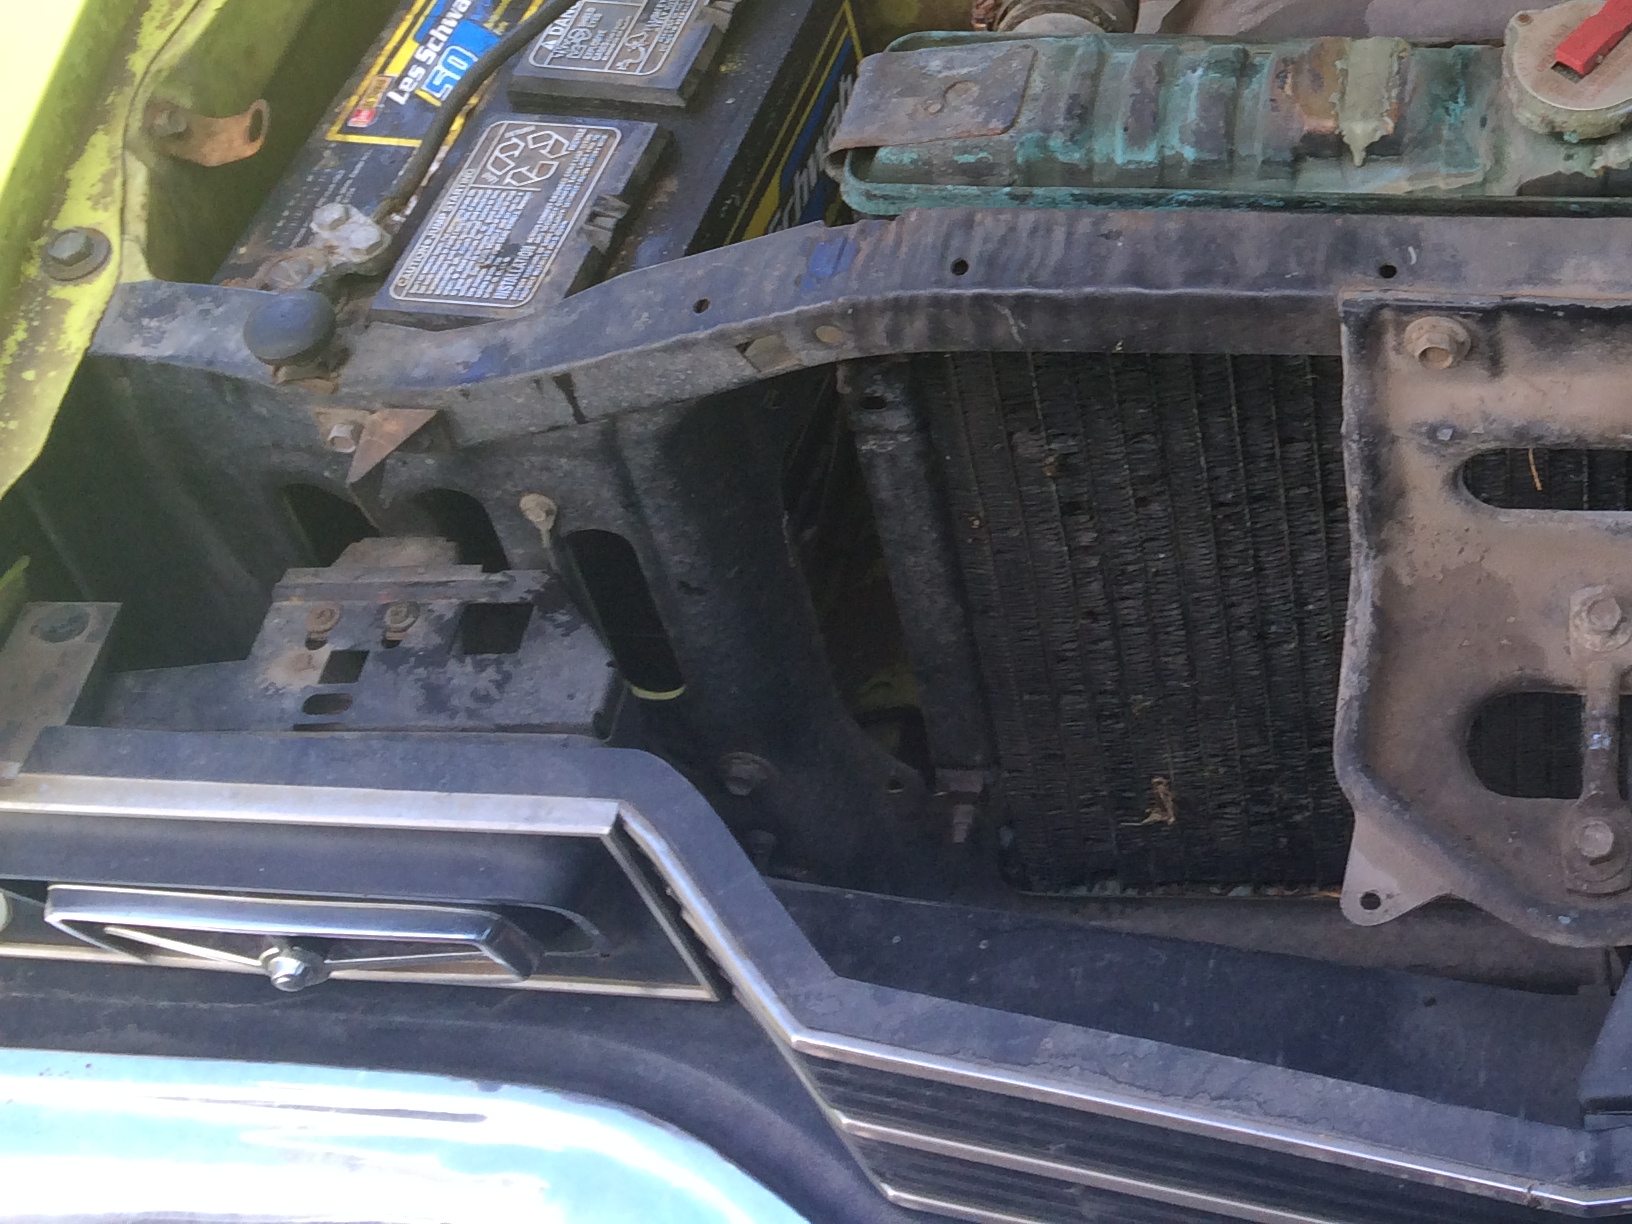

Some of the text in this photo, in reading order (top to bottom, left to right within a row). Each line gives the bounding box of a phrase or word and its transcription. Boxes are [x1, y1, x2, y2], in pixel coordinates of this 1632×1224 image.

[387, 64, 427, 104] Les
[420, 45, 478, 100] 50
[396, 244, 430, 286] CAUTION
[426, 213, 449, 237] JUMP
[492, 245, 536, 299] INSTALLATION
